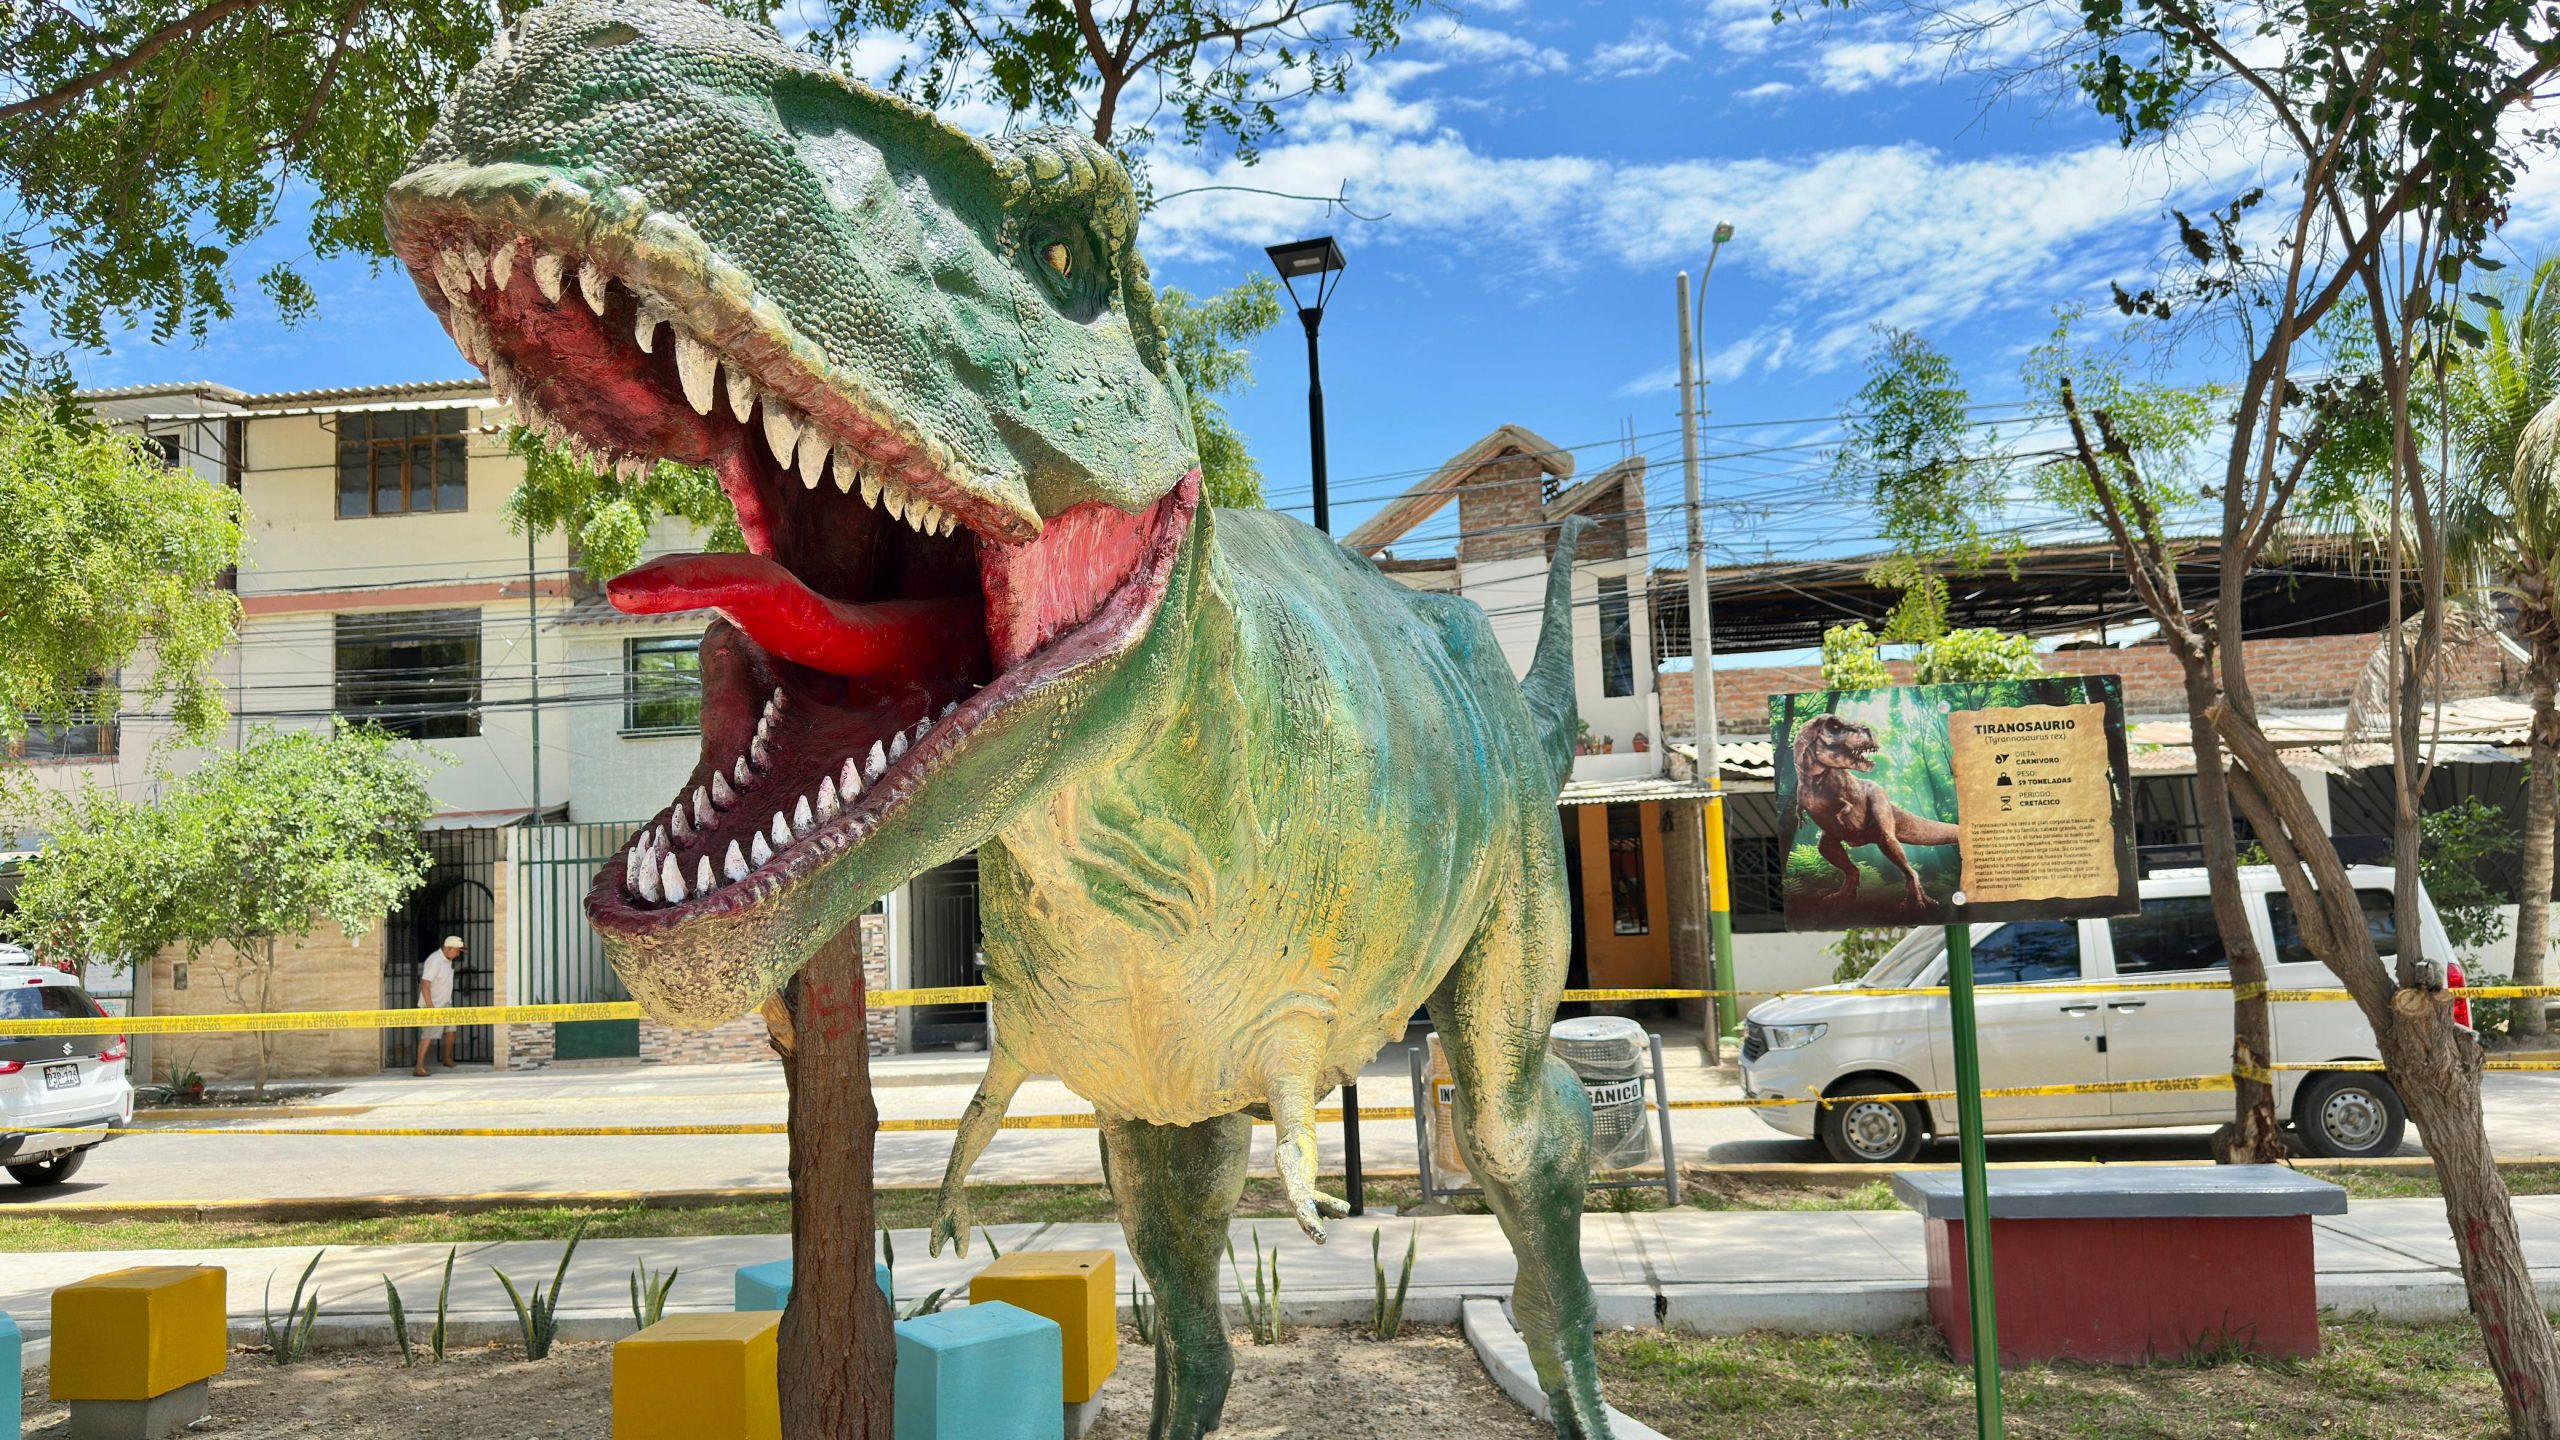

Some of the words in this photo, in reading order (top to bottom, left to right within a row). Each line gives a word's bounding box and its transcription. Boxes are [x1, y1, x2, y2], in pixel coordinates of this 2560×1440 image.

[1974, 720, 2075, 735] TIRANOSAURIO
[1984, 734, 2048, 745] (Tyrannosaurus
[2050, 732, 2066, 740] rex)
[2028, 777, 2072, 785] TONELADAS
[2155, 1083, 2198, 1091] OBRAS
